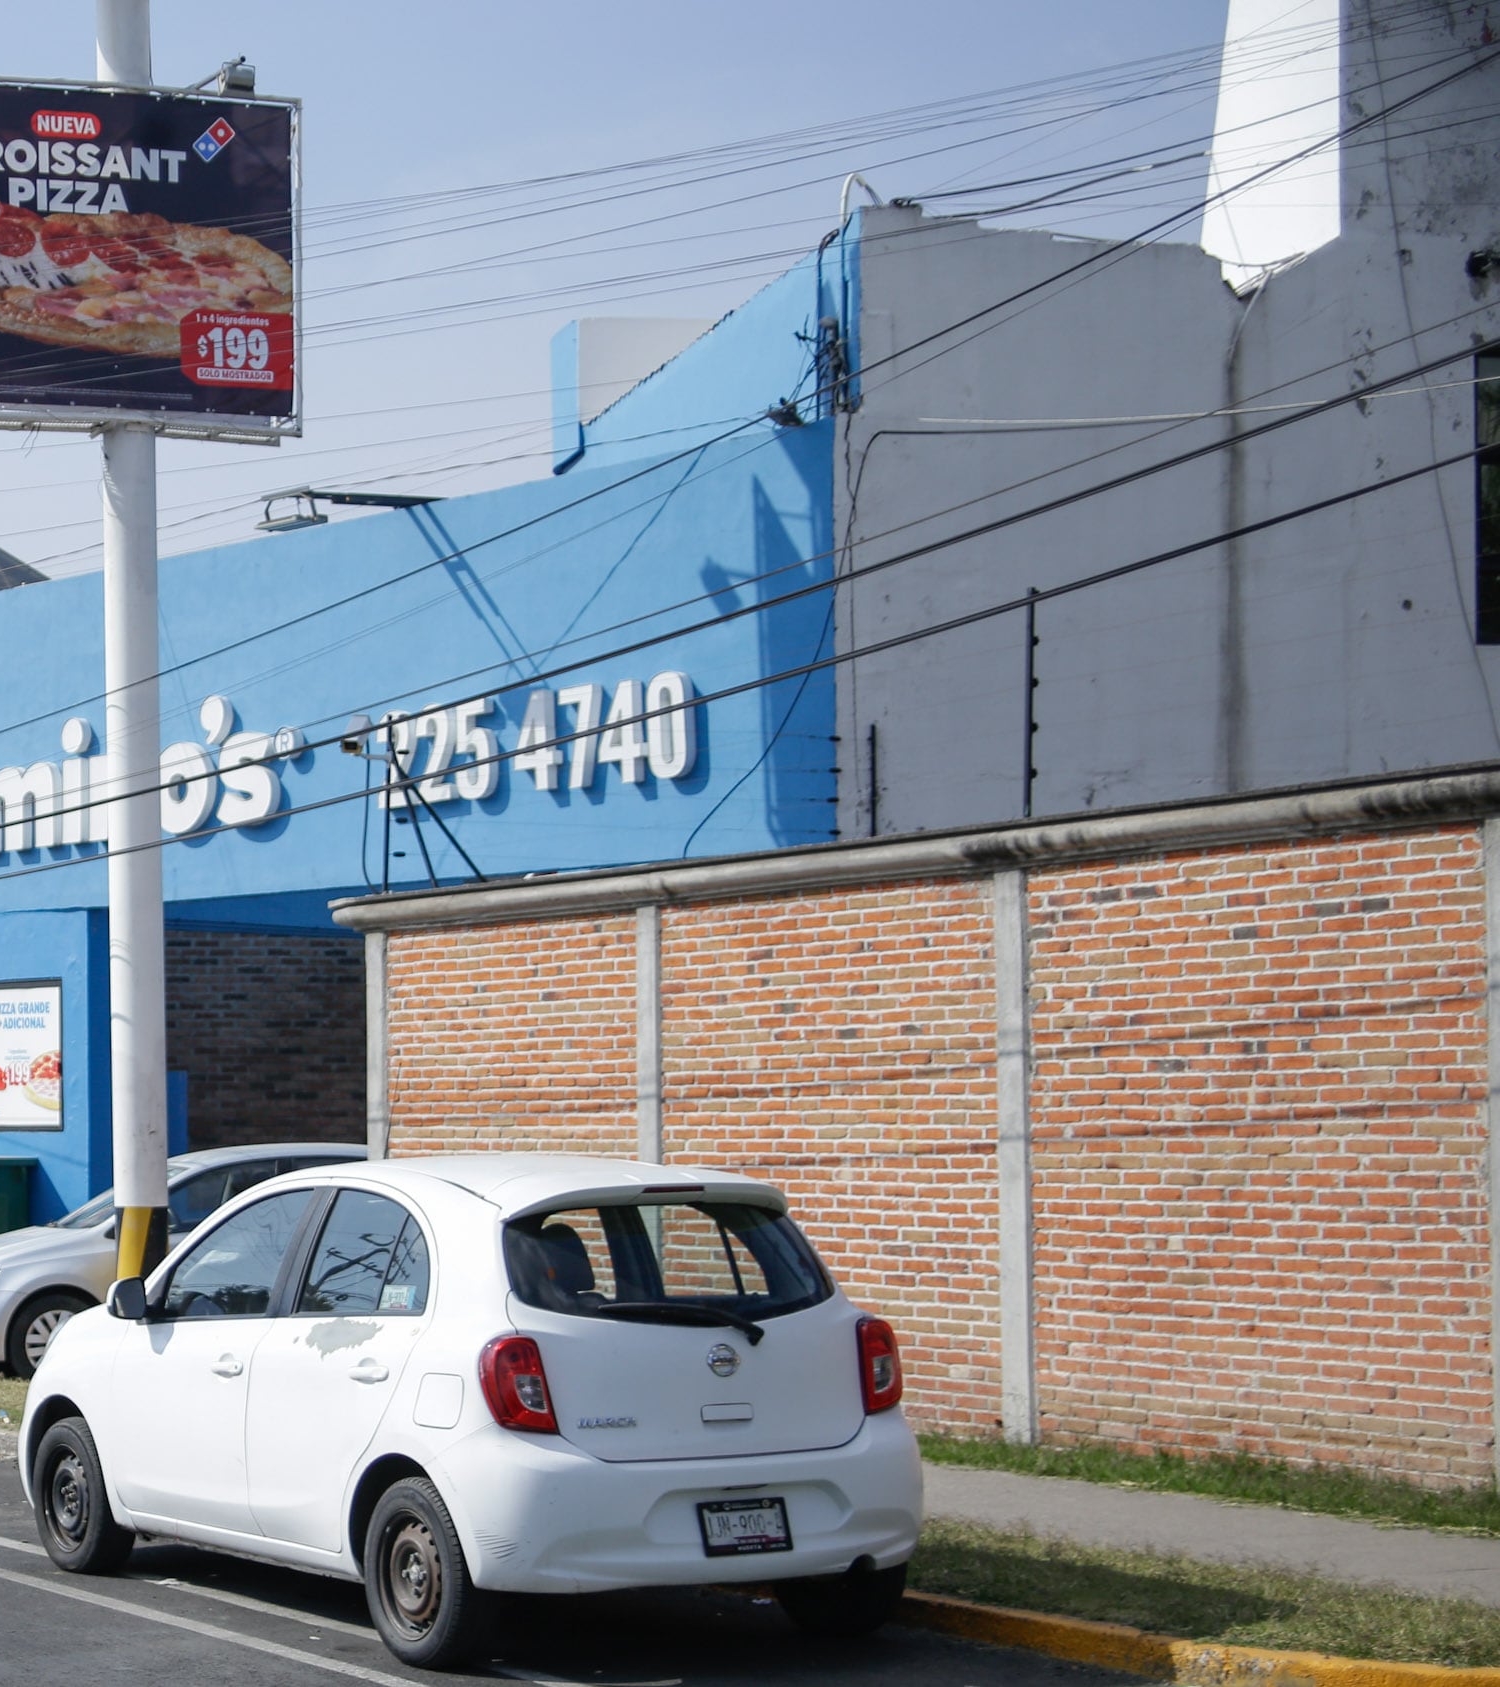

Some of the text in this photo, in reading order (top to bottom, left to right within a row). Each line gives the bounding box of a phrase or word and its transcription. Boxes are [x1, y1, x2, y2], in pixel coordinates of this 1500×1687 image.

[36, 114, 97, 135] NUEVA
[8, 177, 130, 215] PIZZA
[209, 314, 216, 323] 4
[216, 314, 270, 326] ingredientes
[197, 326, 269, 370] $199
[199, 369, 272, 380] SOLO MOSTRADOR
[377, 670, 697, 811] 225 4740
[18, 1001, 50, 1014] GRANDE
